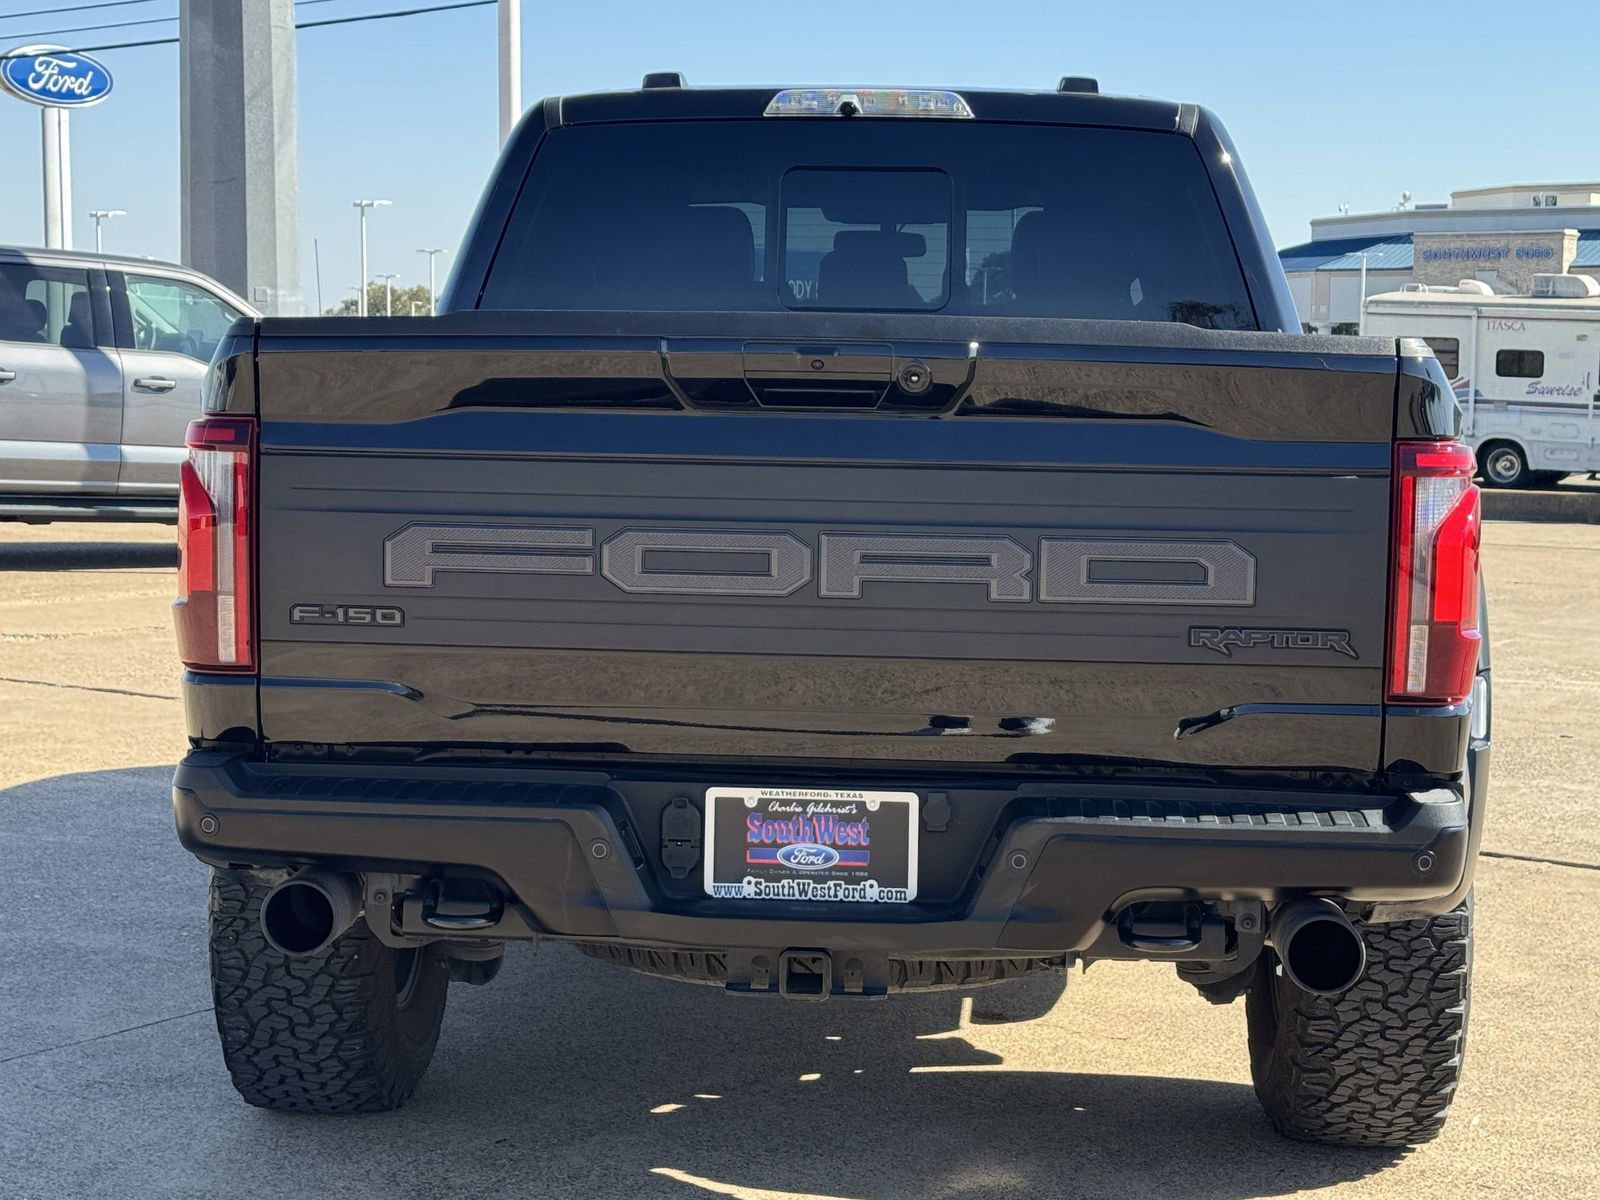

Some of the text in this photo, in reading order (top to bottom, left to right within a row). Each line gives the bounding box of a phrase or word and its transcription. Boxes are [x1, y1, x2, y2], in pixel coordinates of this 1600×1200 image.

[28, 56, 93, 97] Ford
[1422, 247, 1553, 260] SOUTHWEST FORD
[1486, 320, 1526, 331] ITASCA
[1525, 380, 1583, 397] Sunrise
[383, 519, 1257, 607] FORD
[290, 604, 405, 627] F-150
[1188, 626, 1359, 660] RAPTOR
[834, 791, 864, 799] TEXAS
[768, 800, 858, 817] Charlie Gilchrist's
[746, 812, 870, 846] SouthWest
[790, 847, 826, 865] Ford
